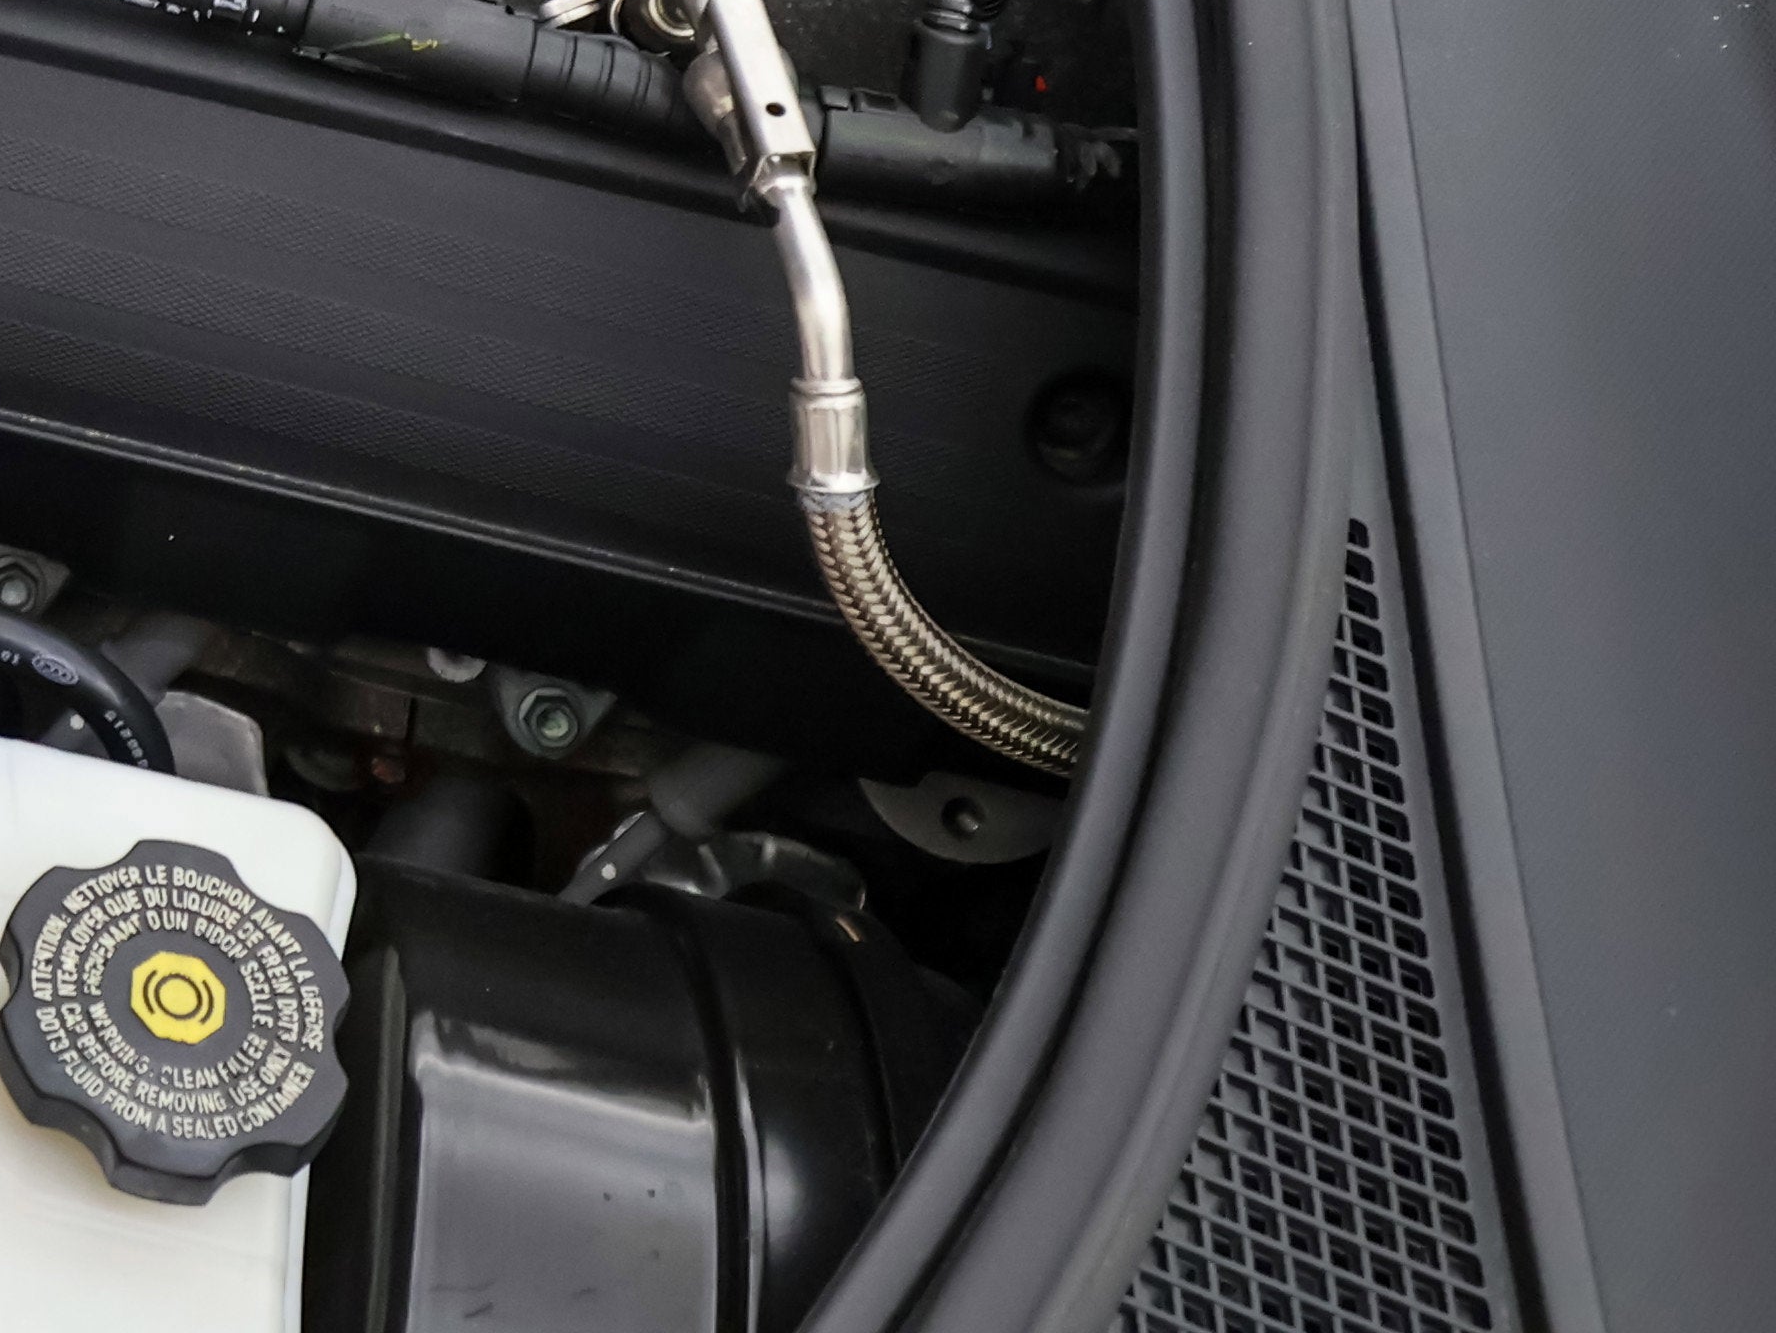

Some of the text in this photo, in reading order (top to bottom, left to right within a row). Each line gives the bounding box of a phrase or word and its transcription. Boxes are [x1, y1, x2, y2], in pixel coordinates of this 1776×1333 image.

[61, 865, 143, 915] NETTOYER
[144, 864, 168, 886] LE
[172, 865, 256, 915] BOUCHON
[249, 907, 302, 957] AVANT
[288, 956, 315, 984] LA
[103, 888, 143, 917] QUE
[142, 886, 168, 909] DU
[172, 887, 241, 930] LIQUIDE
[236, 920, 265, 949] DE
[256, 944, 296, 995] FREIN
[194, 917, 248, 959] BIDON
[35, 1005, 316, 1140] DOT3 FLUID FROM A SEALED CONTAINER
[60, 1001, 89, 1034] CAP
[76, 1032, 136, 1095] BEFORE
[227, 1073, 268, 1107] USE
[258, 1040, 292, 1085] ONLY
[160, 1064, 220, 1090] CLEAN
